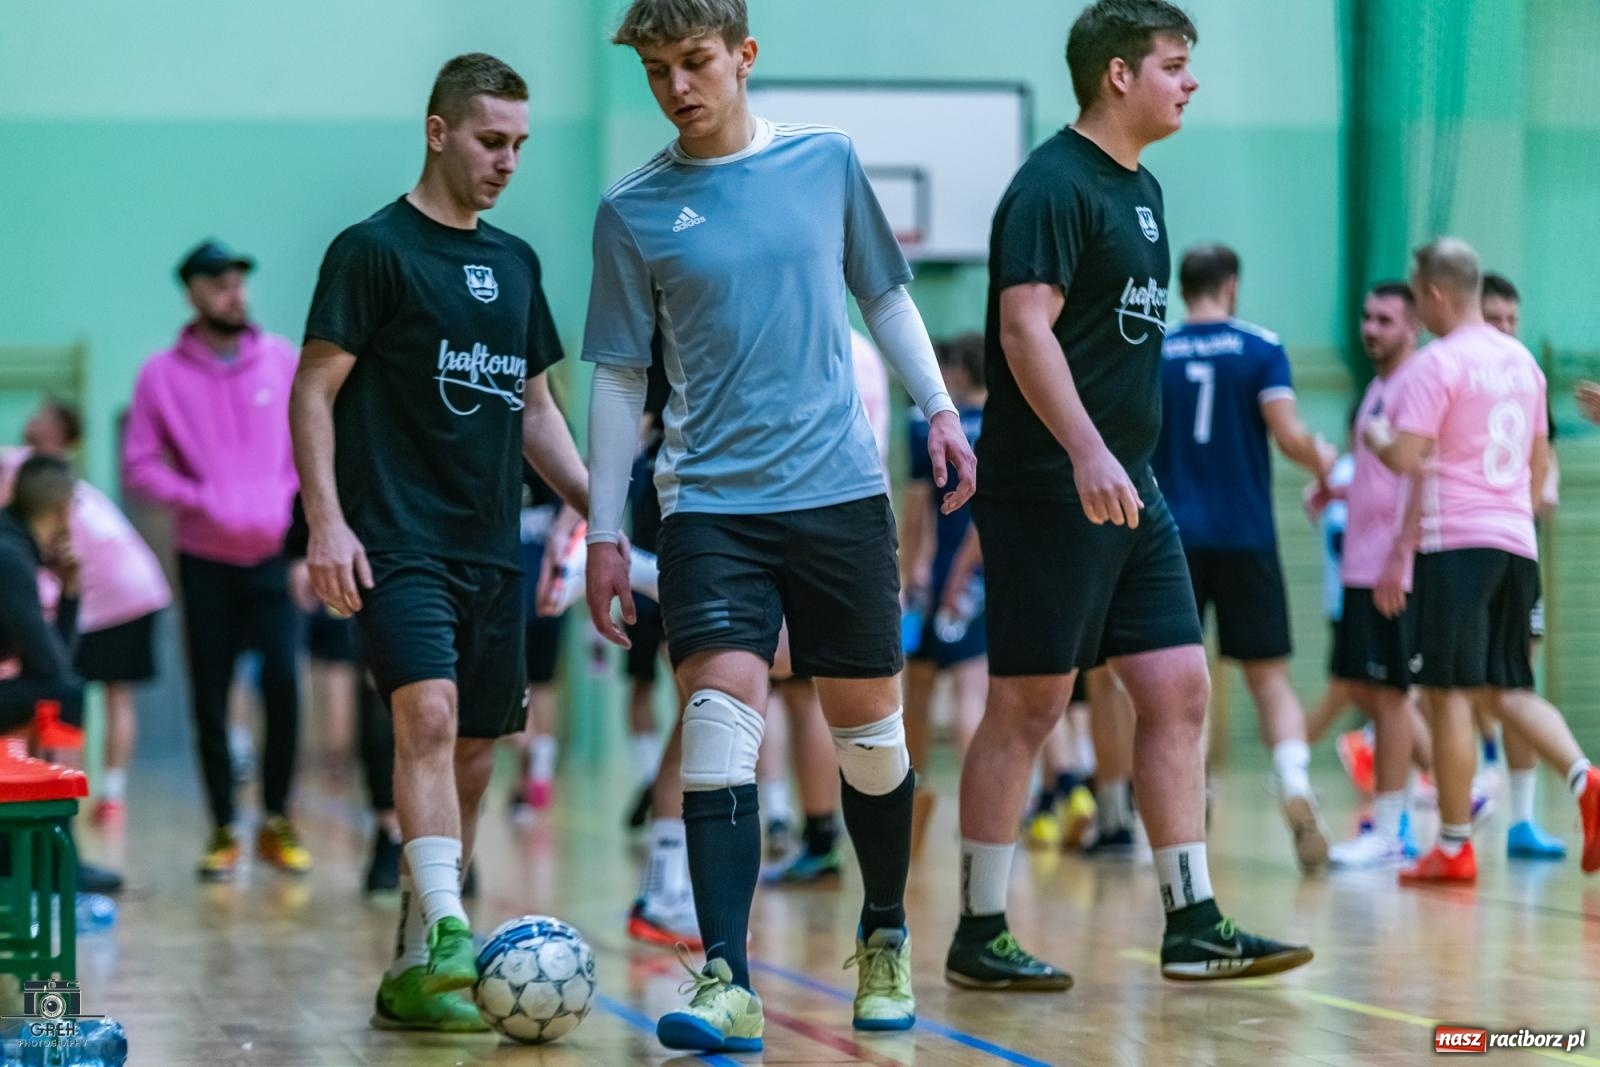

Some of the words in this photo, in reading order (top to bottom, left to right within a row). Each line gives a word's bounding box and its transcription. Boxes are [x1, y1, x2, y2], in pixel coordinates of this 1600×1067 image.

[672, 215, 706, 232] adidas
[1185, 362, 1215, 444] 7
[1484, 400, 1526, 487] 8
